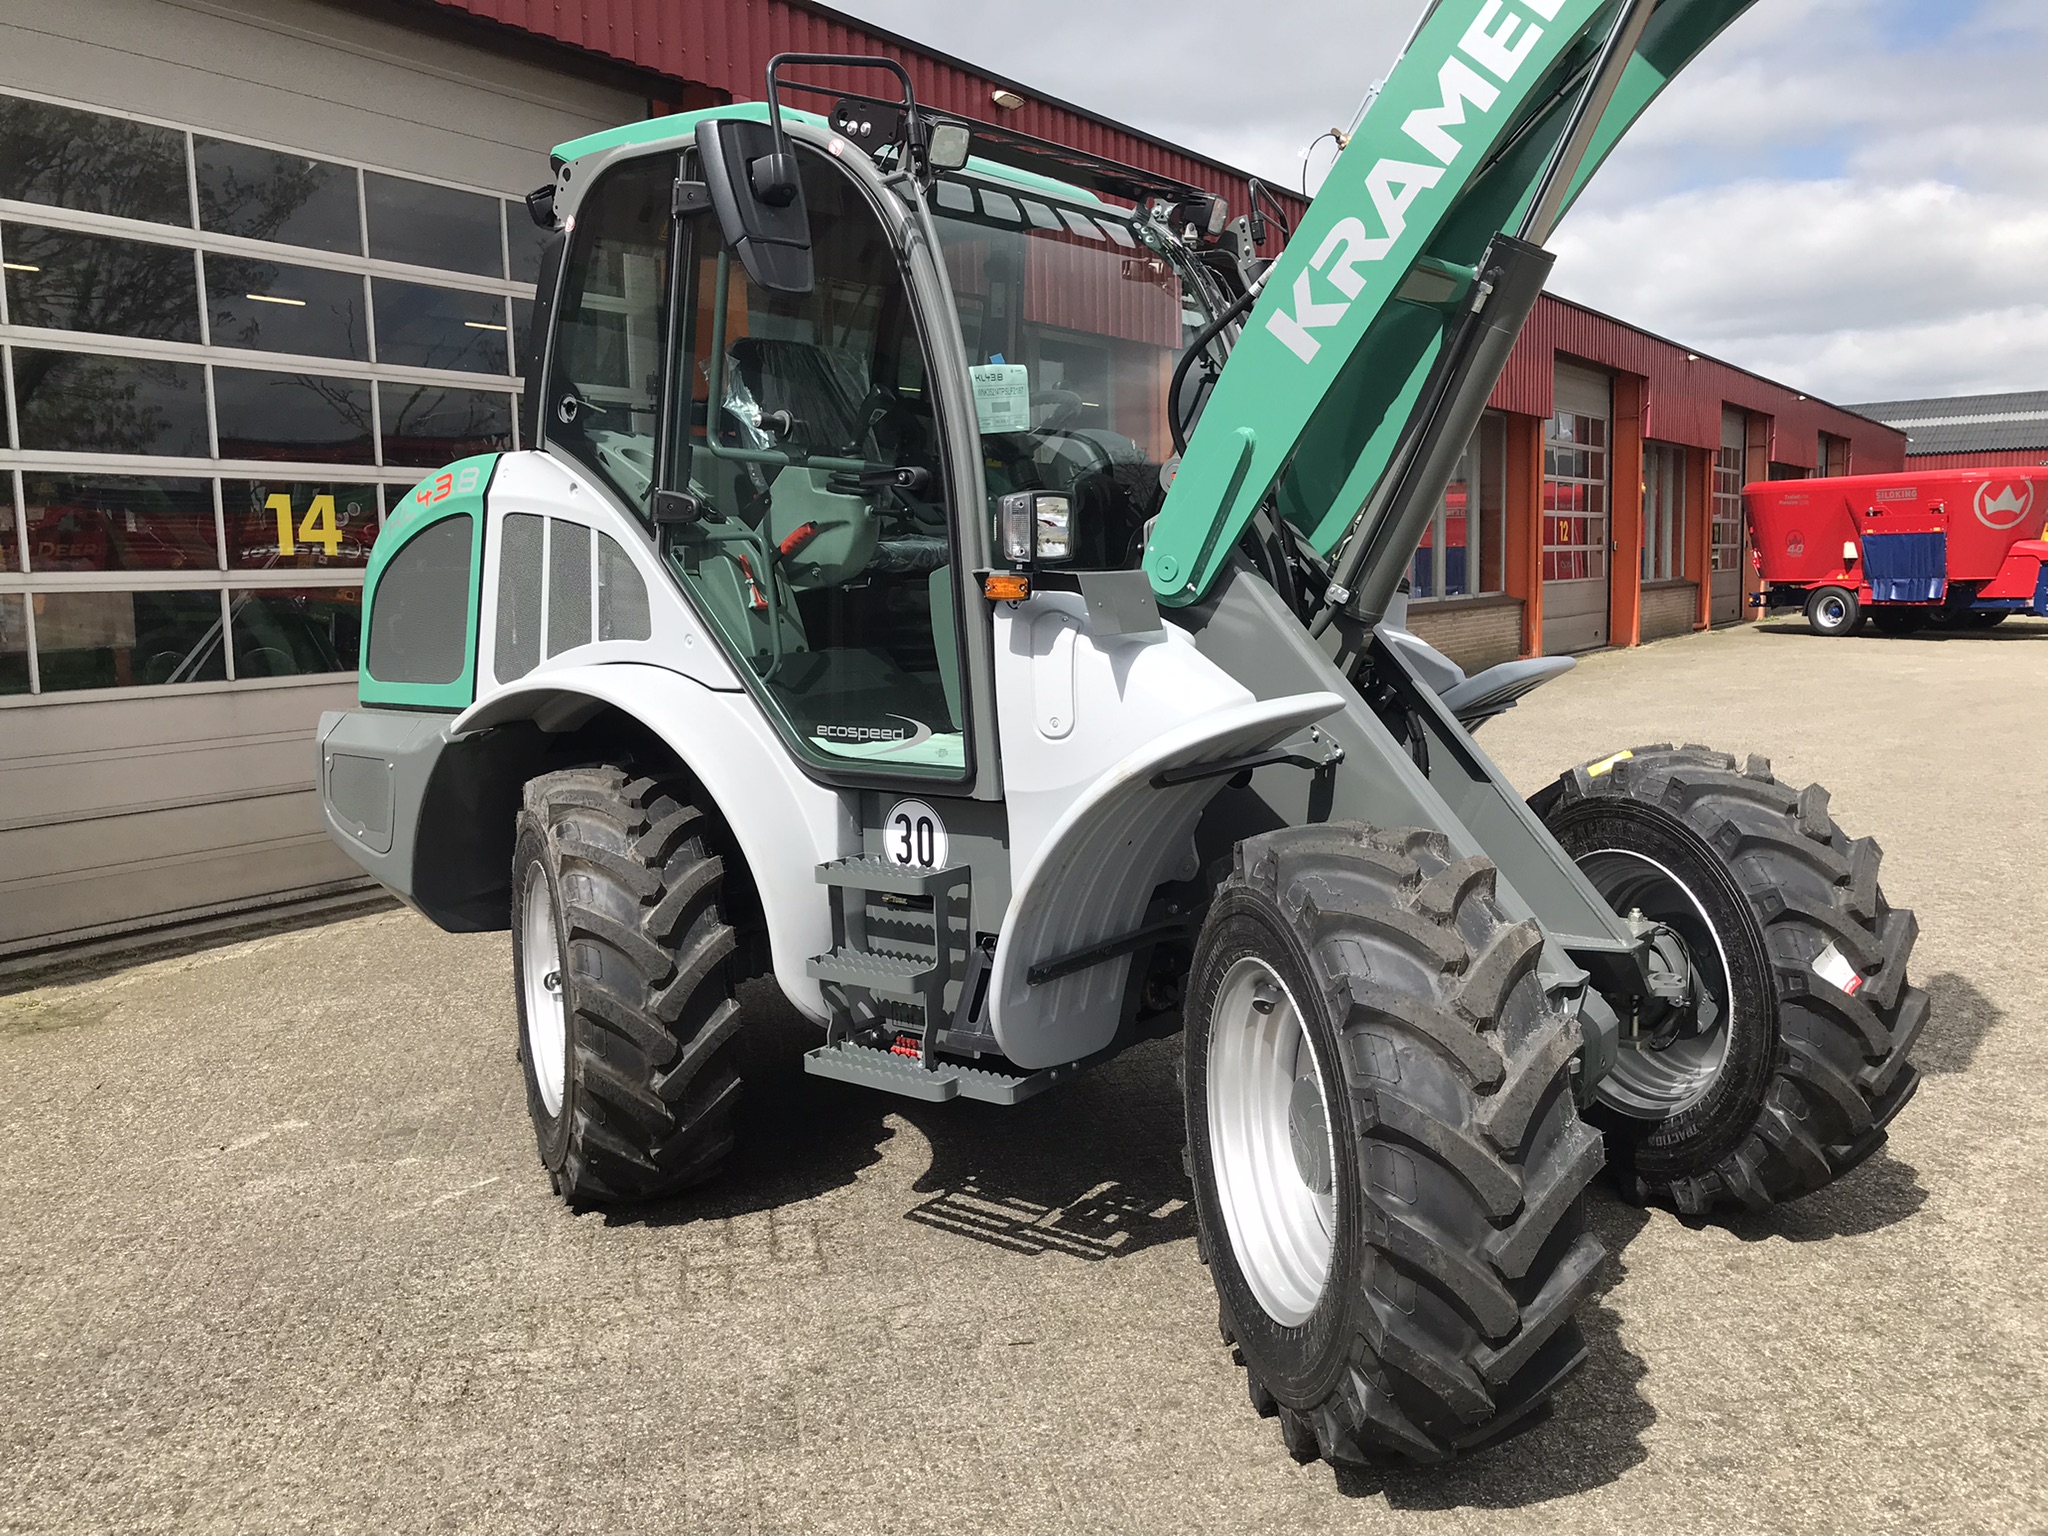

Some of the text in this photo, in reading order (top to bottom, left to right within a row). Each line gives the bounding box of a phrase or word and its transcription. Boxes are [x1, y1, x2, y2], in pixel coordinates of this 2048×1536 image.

[1875, 490, 1917, 500] SILOKING
[265, 493, 343, 556] 14
[1559, 520, 1569, 542] 12
[816, 724, 904, 741] ecospeed
[894, 813, 934, 867] 30
